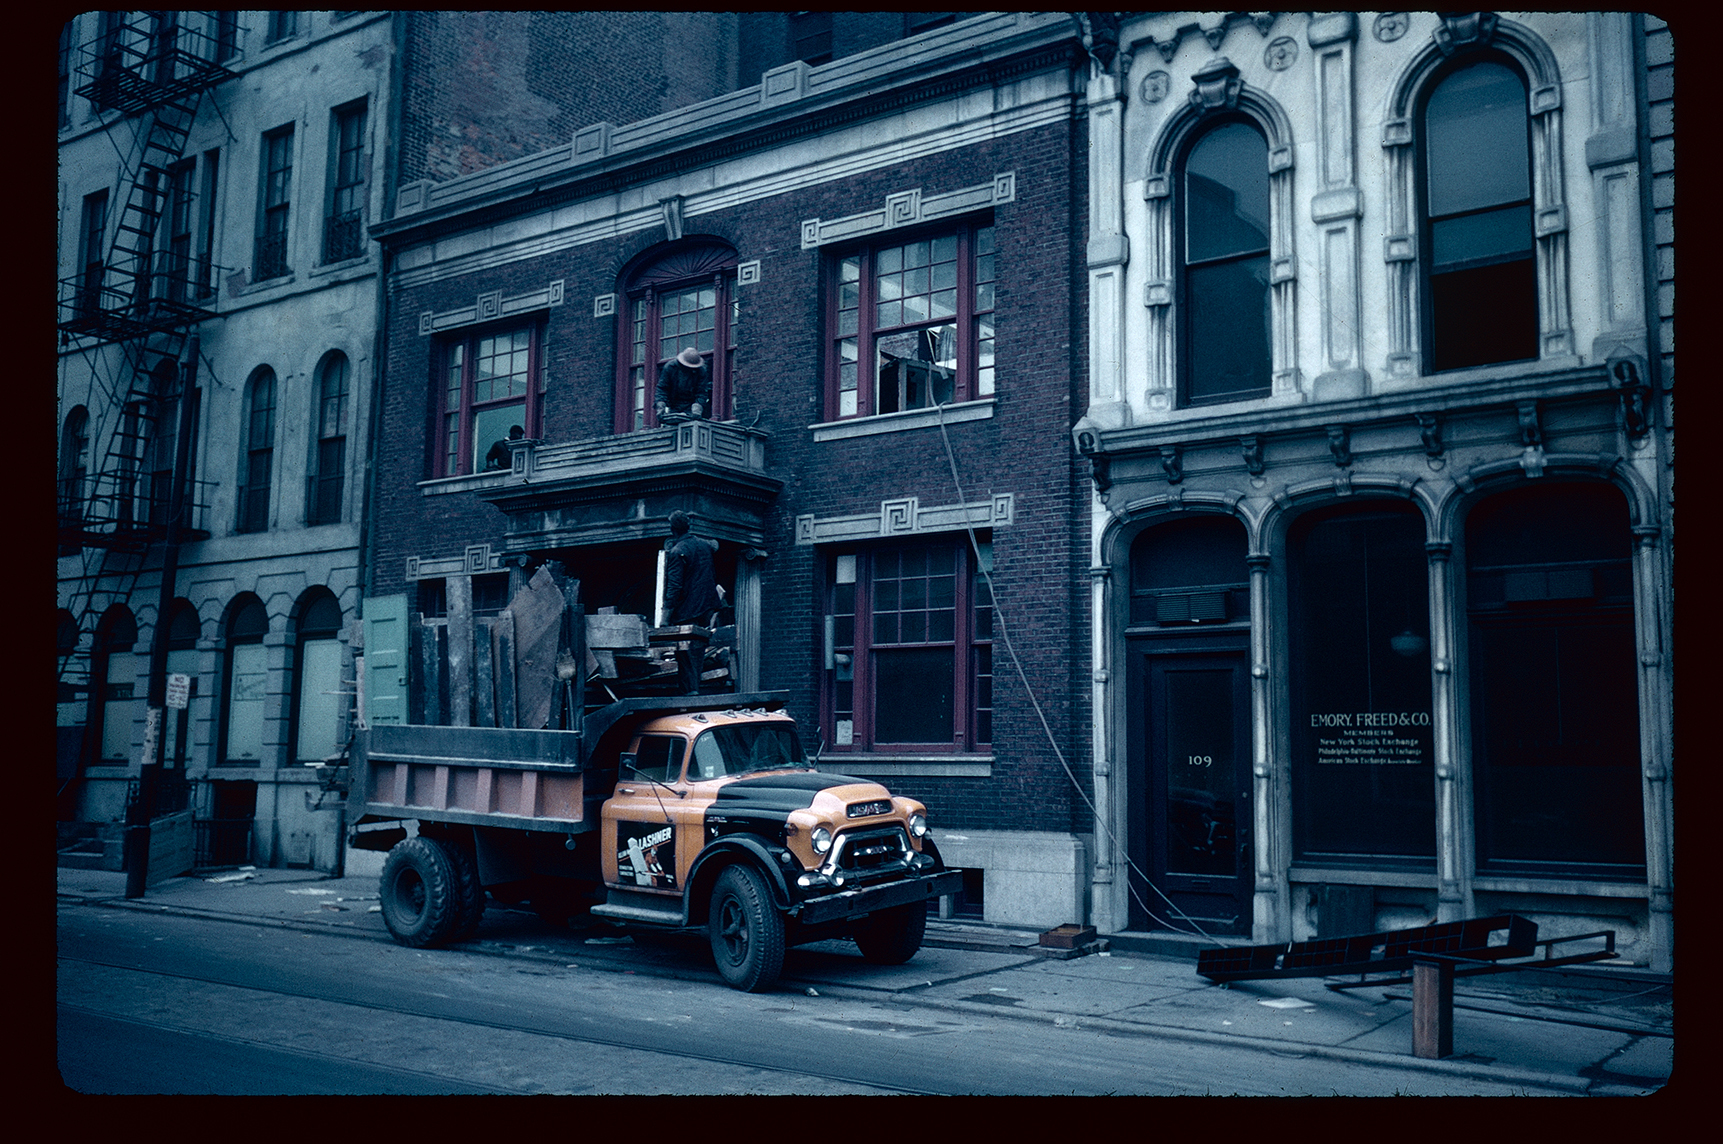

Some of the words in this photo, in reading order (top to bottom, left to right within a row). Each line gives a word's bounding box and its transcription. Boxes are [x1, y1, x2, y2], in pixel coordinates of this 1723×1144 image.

[1357, 738, 1380, 746] Stock
[1382, 738, 1419, 747] Exchange
[1188, 755, 1213, 768] 109
[638, 827, 673, 850] LASHNER
